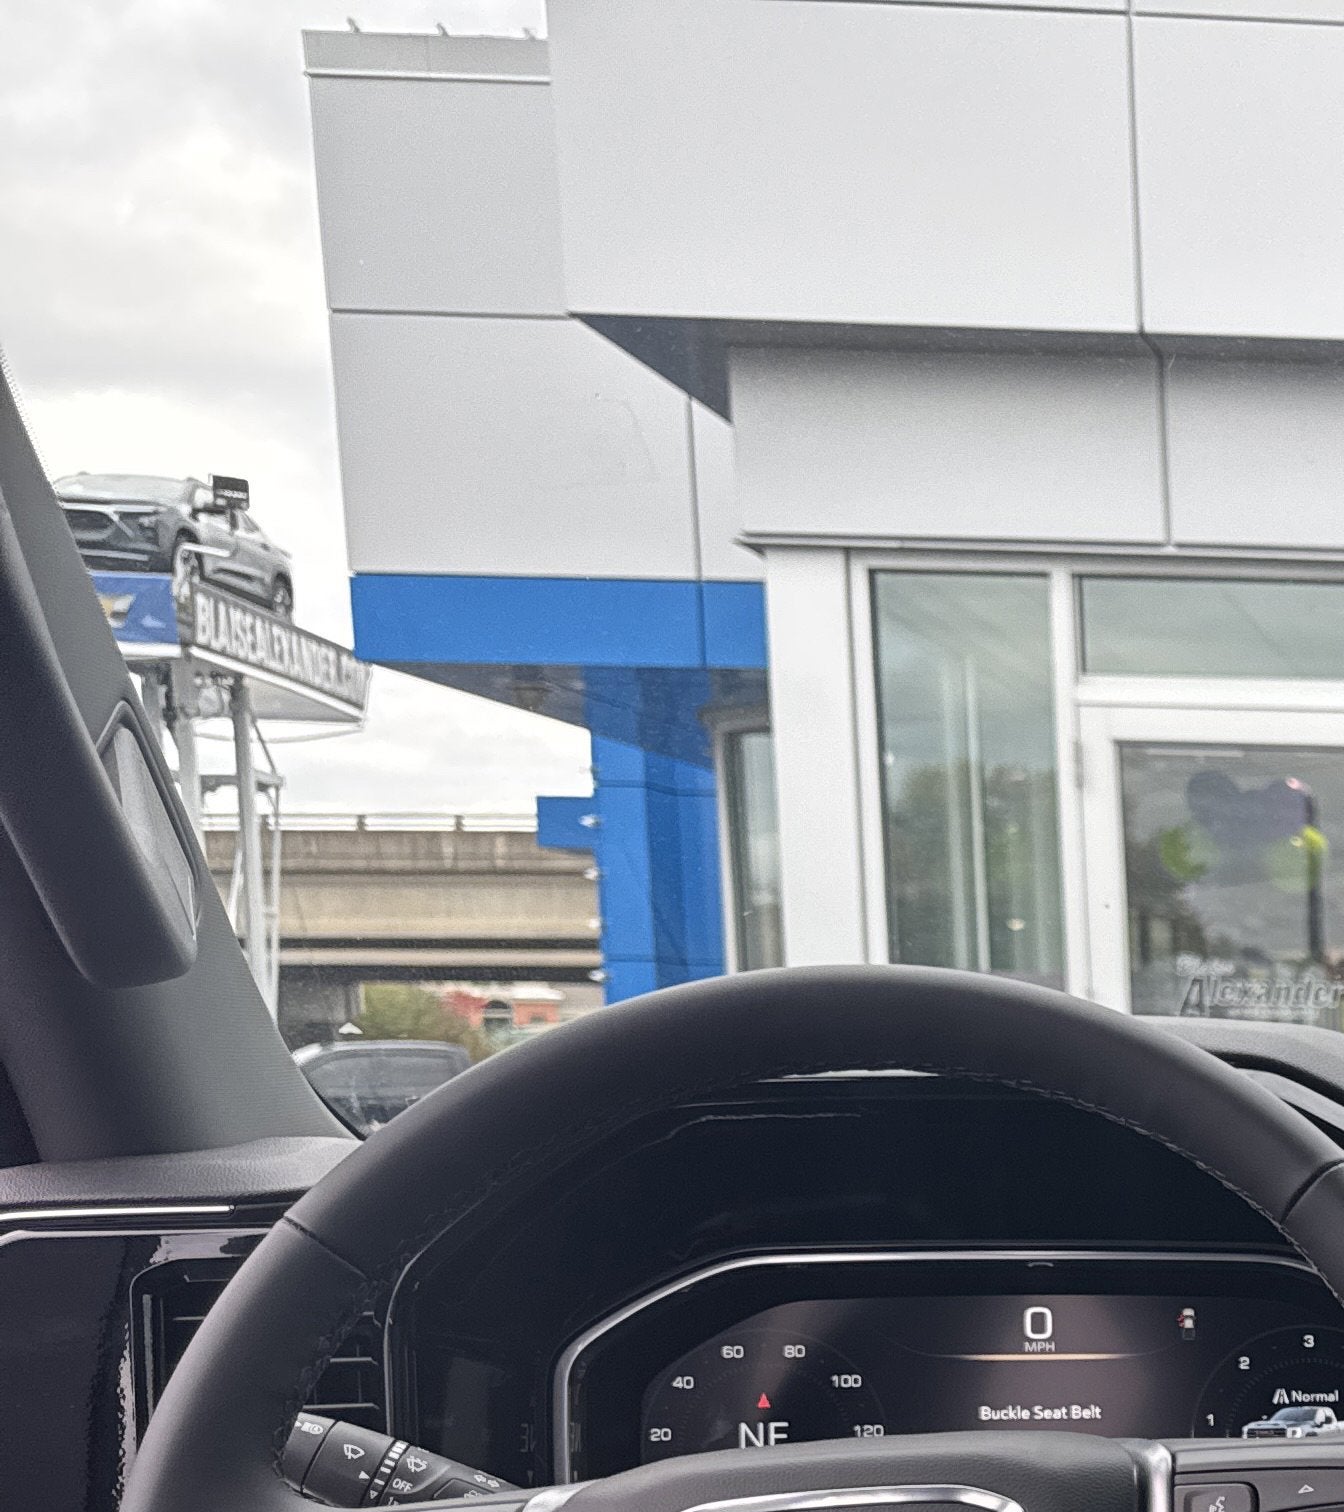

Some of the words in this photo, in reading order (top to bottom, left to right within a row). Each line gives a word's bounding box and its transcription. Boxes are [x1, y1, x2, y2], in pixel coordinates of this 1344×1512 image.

[1023, 1306, 1053, 1340] 0
[1024, 1341, 1055, 1352] MPH
[1303, 1334, 1315, 1348] 3
[721, 1345, 744, 1359] 60
[783, 1345, 805, 1359] 80
[1238, 1356, 1250, 1370] 2
[672, 1376, 694, 1390] 40
[831, 1374, 861, 1388] 100
[1291, 1389, 1339, 1402] Normal
[979, 1405, 1030, 1420] Buckle
[1033, 1405, 1068, 1420] Seat
[1070, 1404, 1102, 1419] Belt
[1206, 1413, 1215, 1427] 1
[650, 1428, 671, 1442] 20
[854, 1424, 884, 1439] 120
[393, 1478, 413, 1492] OFF
